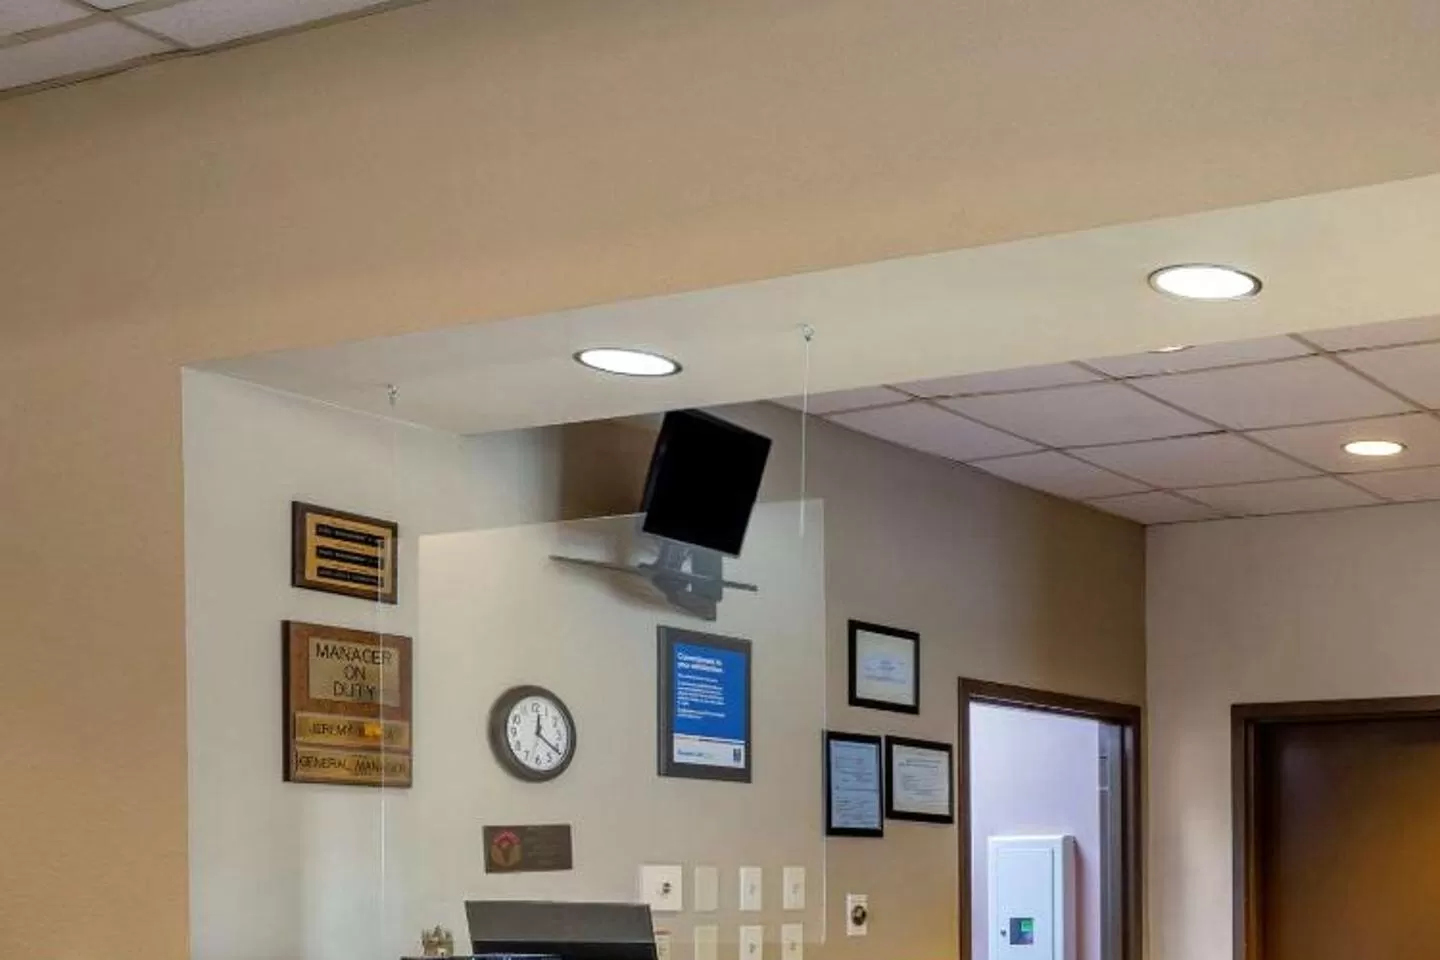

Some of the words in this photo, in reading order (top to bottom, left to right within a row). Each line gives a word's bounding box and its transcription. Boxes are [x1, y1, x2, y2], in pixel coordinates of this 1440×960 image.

[316, 642, 392, 666] MANAGER
[343, 664, 366, 681] ON
[333, 681, 376, 698] DUTY
